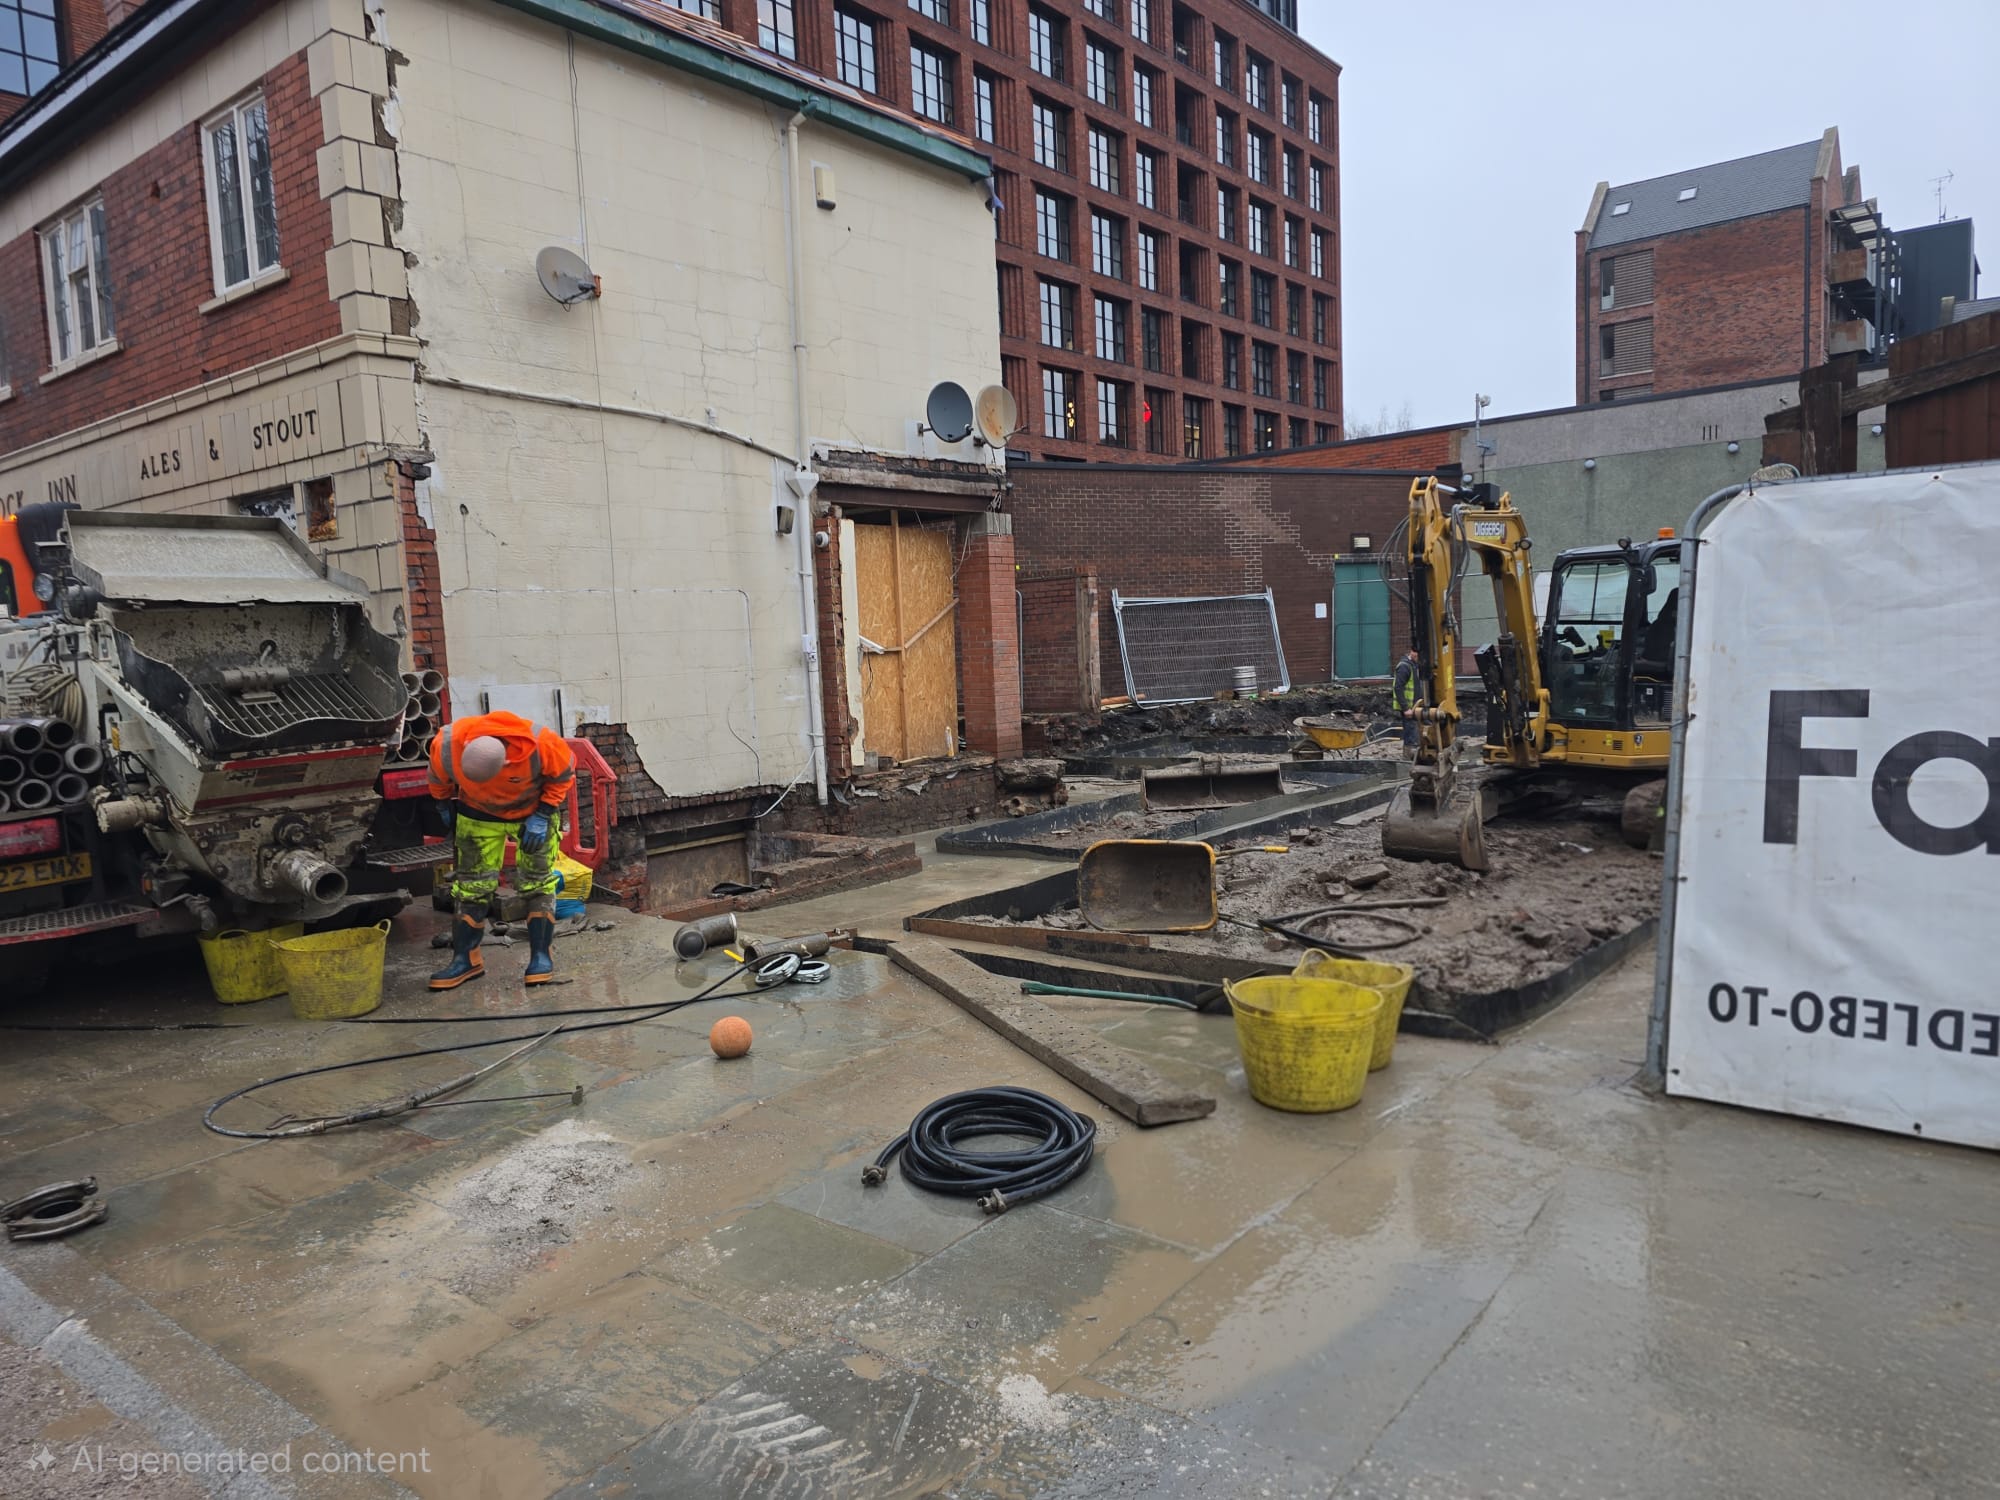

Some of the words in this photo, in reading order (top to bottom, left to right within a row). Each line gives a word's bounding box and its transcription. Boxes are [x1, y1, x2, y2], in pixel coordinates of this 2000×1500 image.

[47, 475, 77, 504] INN
[140, 450, 181, 480] ALES
[208, 438, 220, 461] &
[253, 410, 317, 450] STOUT
